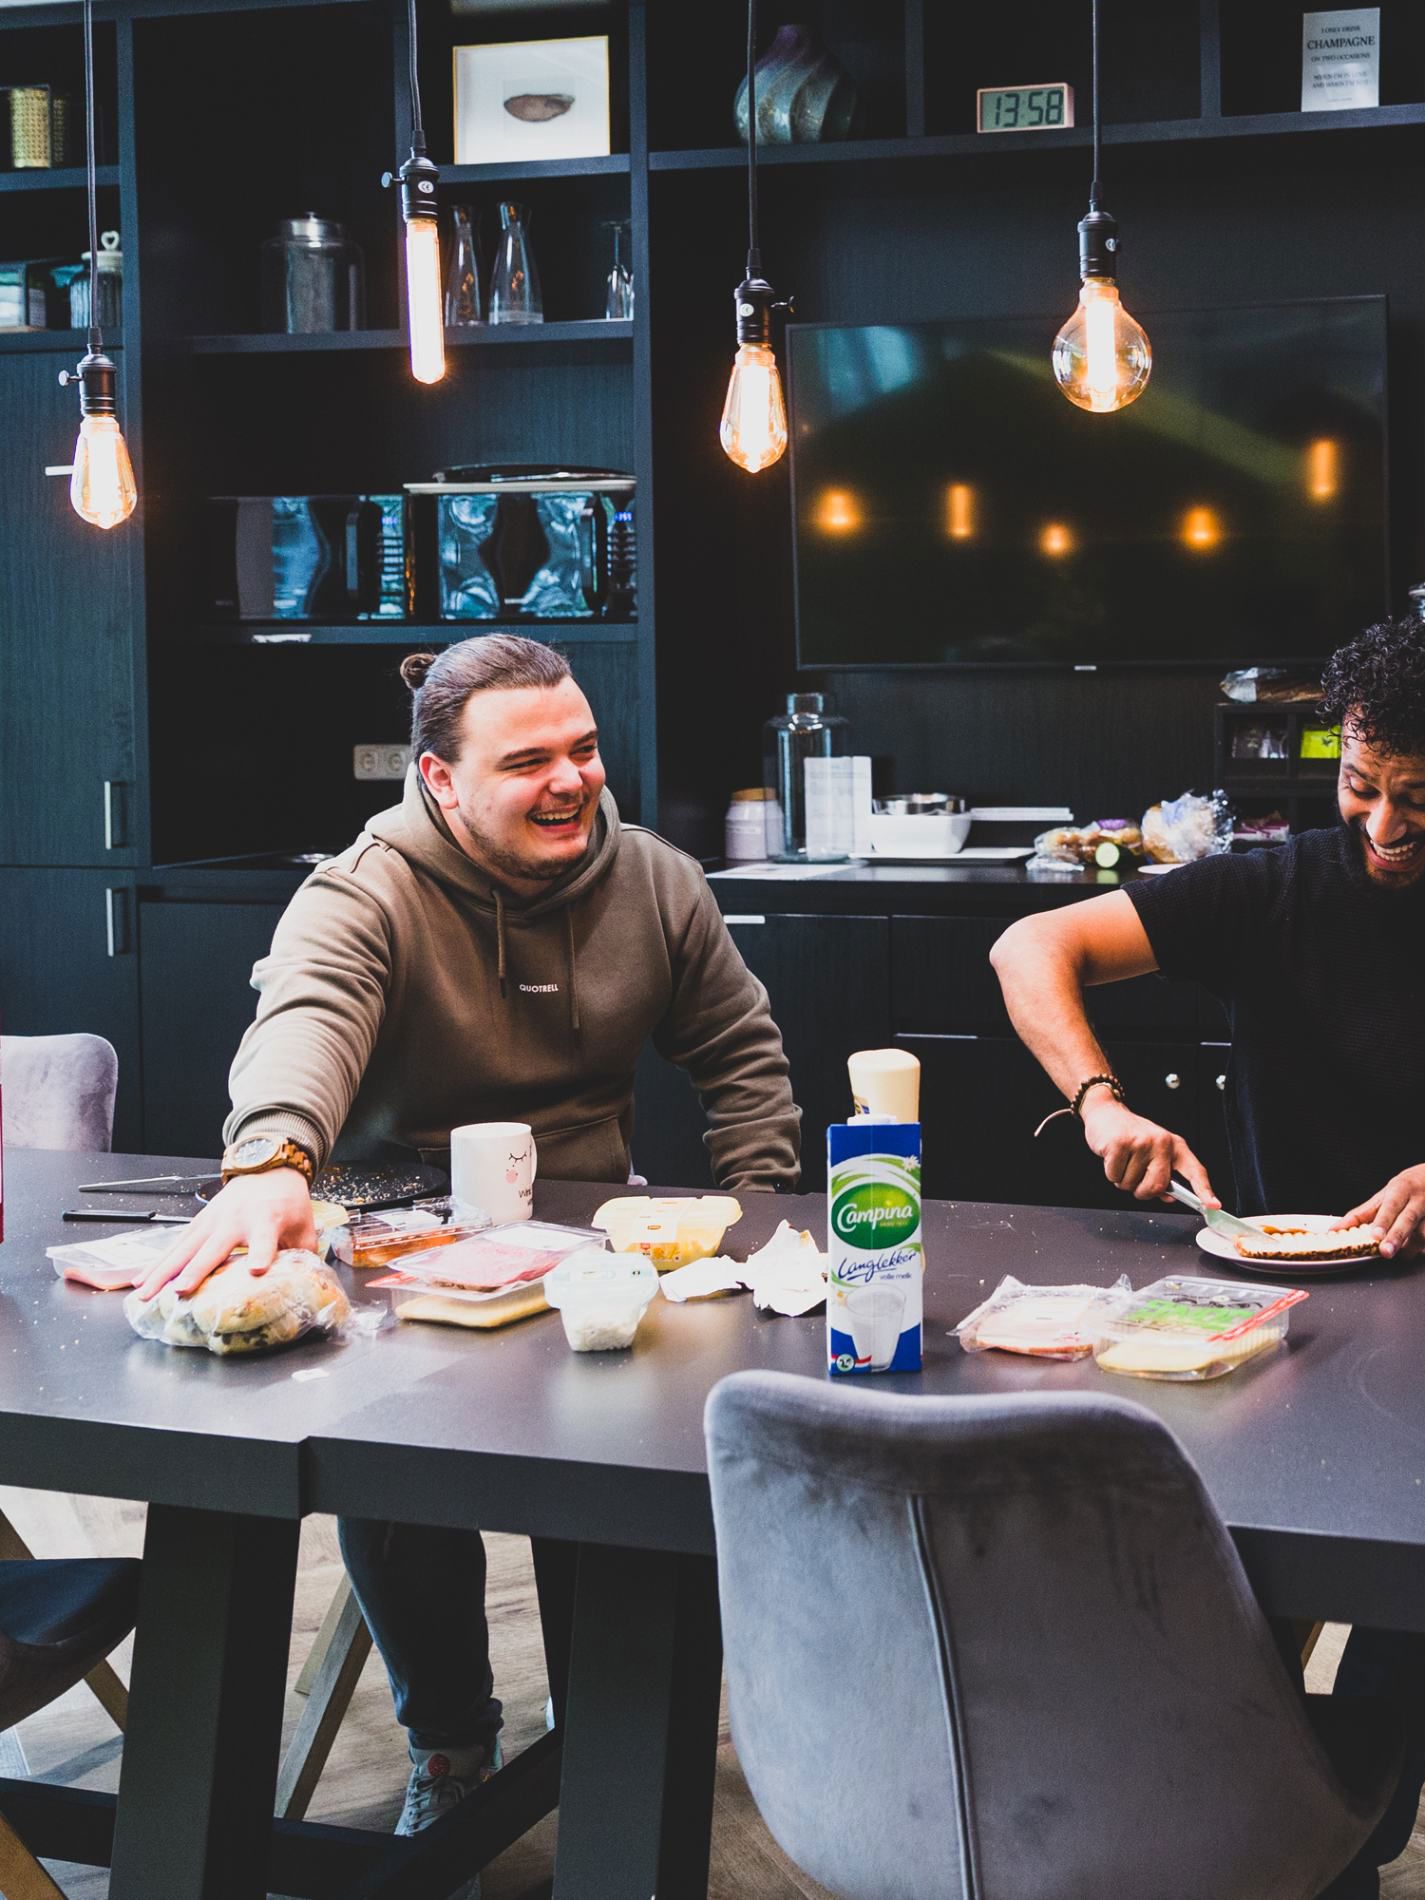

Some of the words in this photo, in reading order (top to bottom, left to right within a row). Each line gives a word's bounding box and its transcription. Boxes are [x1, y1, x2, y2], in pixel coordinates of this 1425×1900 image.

[1307, 35, 1376, 49] CHAMPAGNE
[995, 90, 1064, 127] 13:58
[519, 984, 559, 992] QUOTRELL
[837, 1204, 913, 1233] Campina
[838, 1250, 917, 1283] Langlekker
